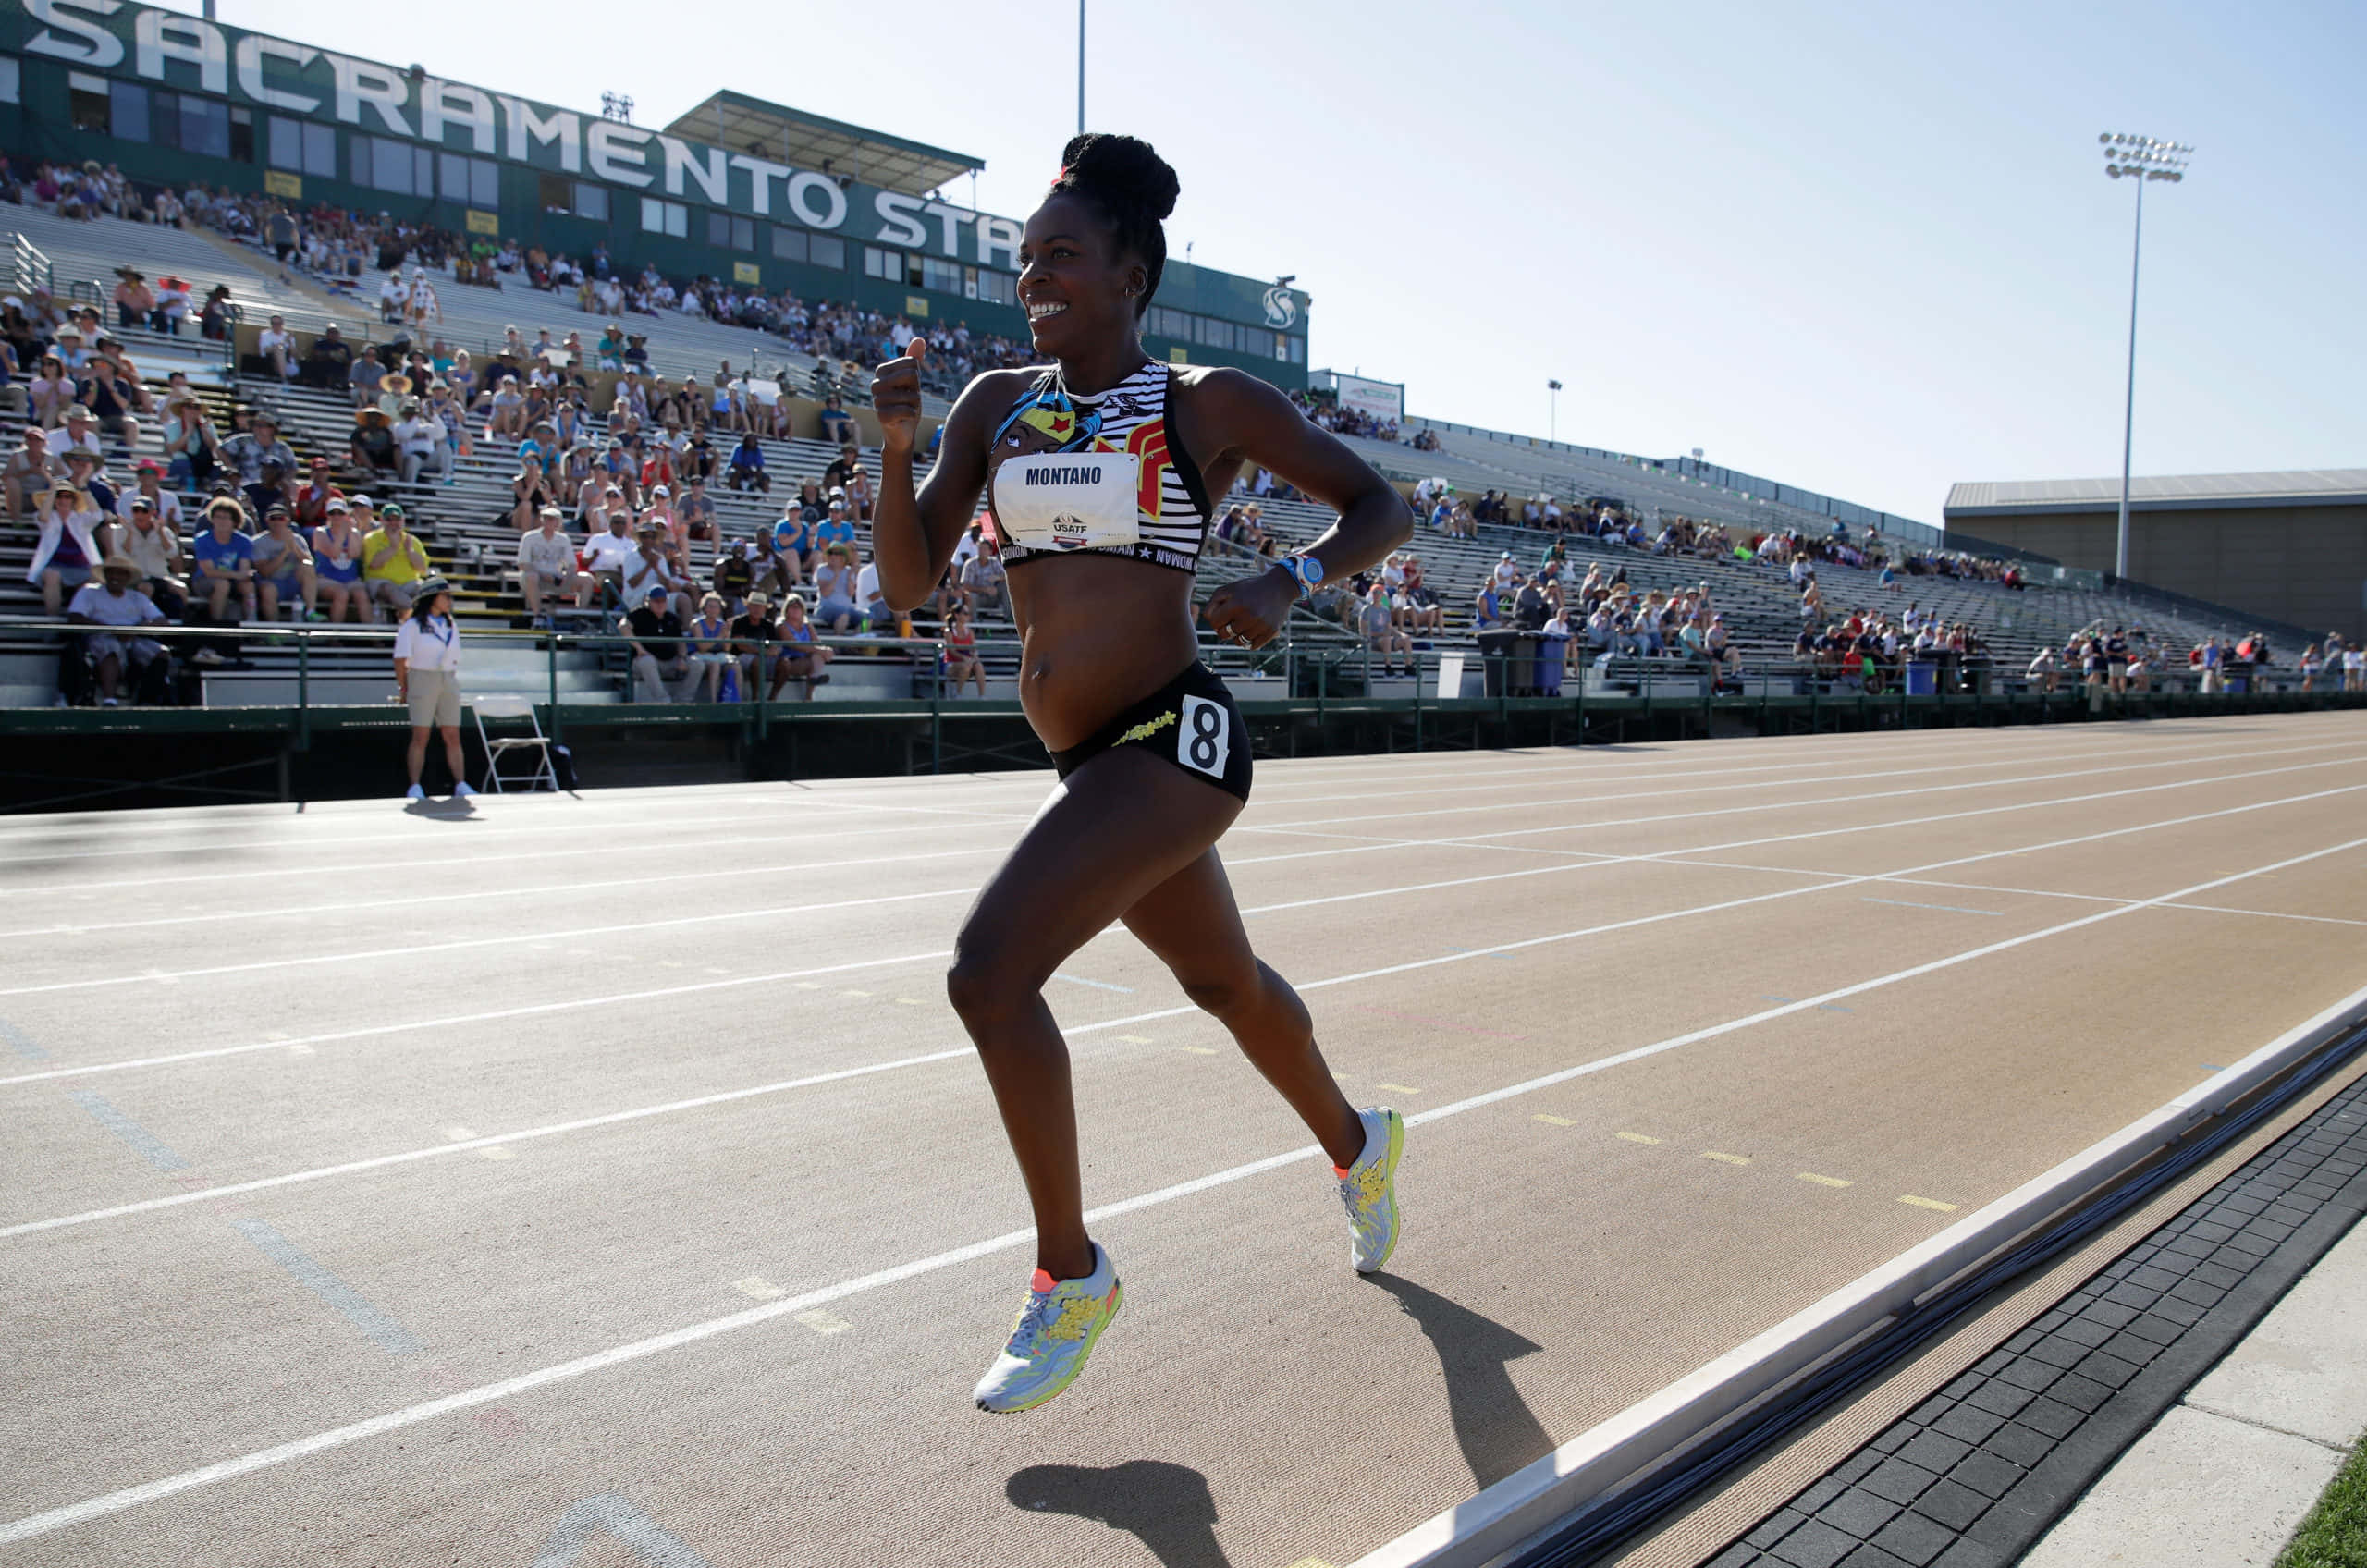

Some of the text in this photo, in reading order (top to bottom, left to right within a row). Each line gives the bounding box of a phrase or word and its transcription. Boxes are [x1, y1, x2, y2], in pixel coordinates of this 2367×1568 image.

[23, 0, 1022, 272] SACRAMENTO STA
[1025, 466, 1101, 486] MONTANO
[1053, 524, 1087, 534] USATF
[1190, 703, 1221, 769] 8
